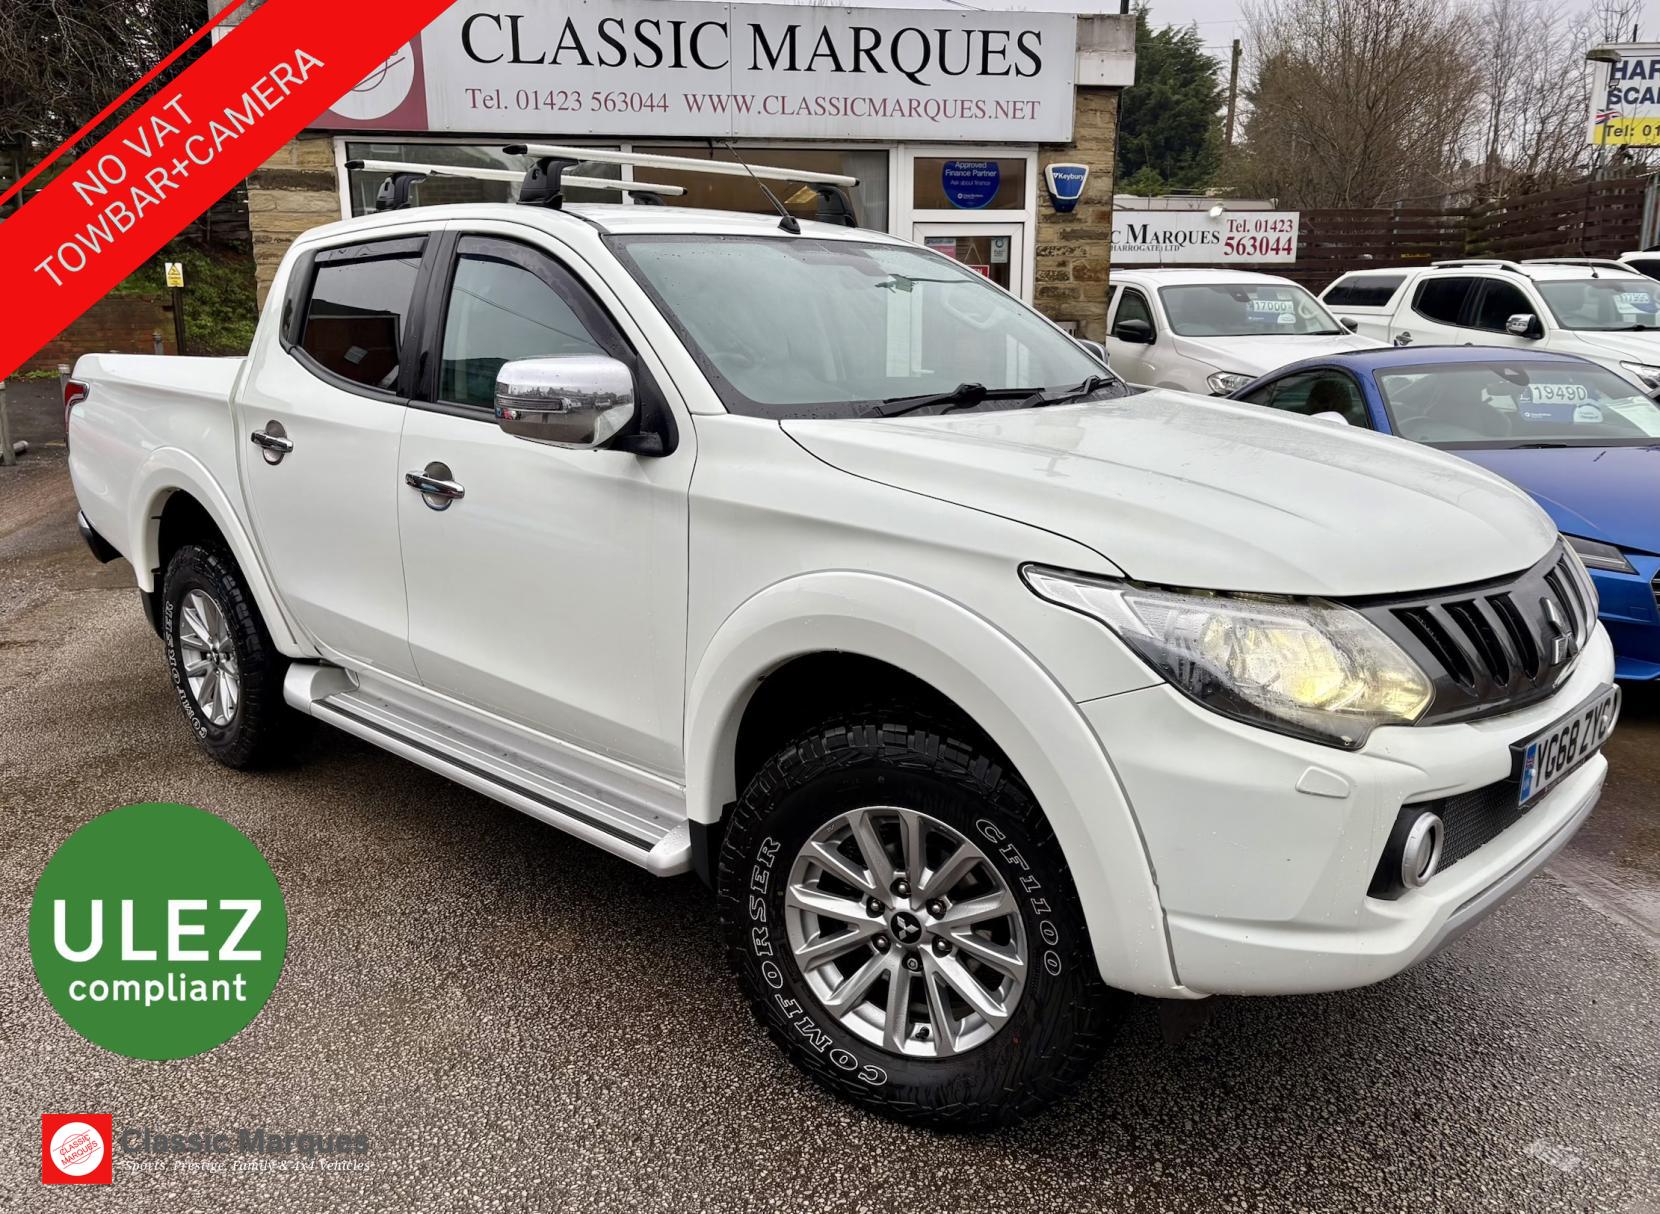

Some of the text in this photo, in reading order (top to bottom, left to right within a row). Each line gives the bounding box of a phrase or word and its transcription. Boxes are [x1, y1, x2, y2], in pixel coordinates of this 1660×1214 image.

[461, 13, 1043, 86] CLASSIC MARQUES
[465, 88, 1041, 121] Tel. 01423 563044 WWW.CLASSICMARQUES.NET
[1607, 86, 1660, 105] SCA
[1606, 125, 1635, 137] Tel:
[945, 169, 997, 177] Finance Partner
[955, 161, 987, 169] Approved
[1057, 172, 1085, 182] Keybury
[1126, 224, 1220, 247] MARQUES
[1226, 219, 1293, 233] Tel. 01423
[1223, 236, 1293, 257] 563044
[1536, 720, 1580, 788] YG68
[1579, 698, 1611, 756] ZYC
[975, 818, 1062, 976] CF1100
[749, 836, 888, 1086] COMFORSER
